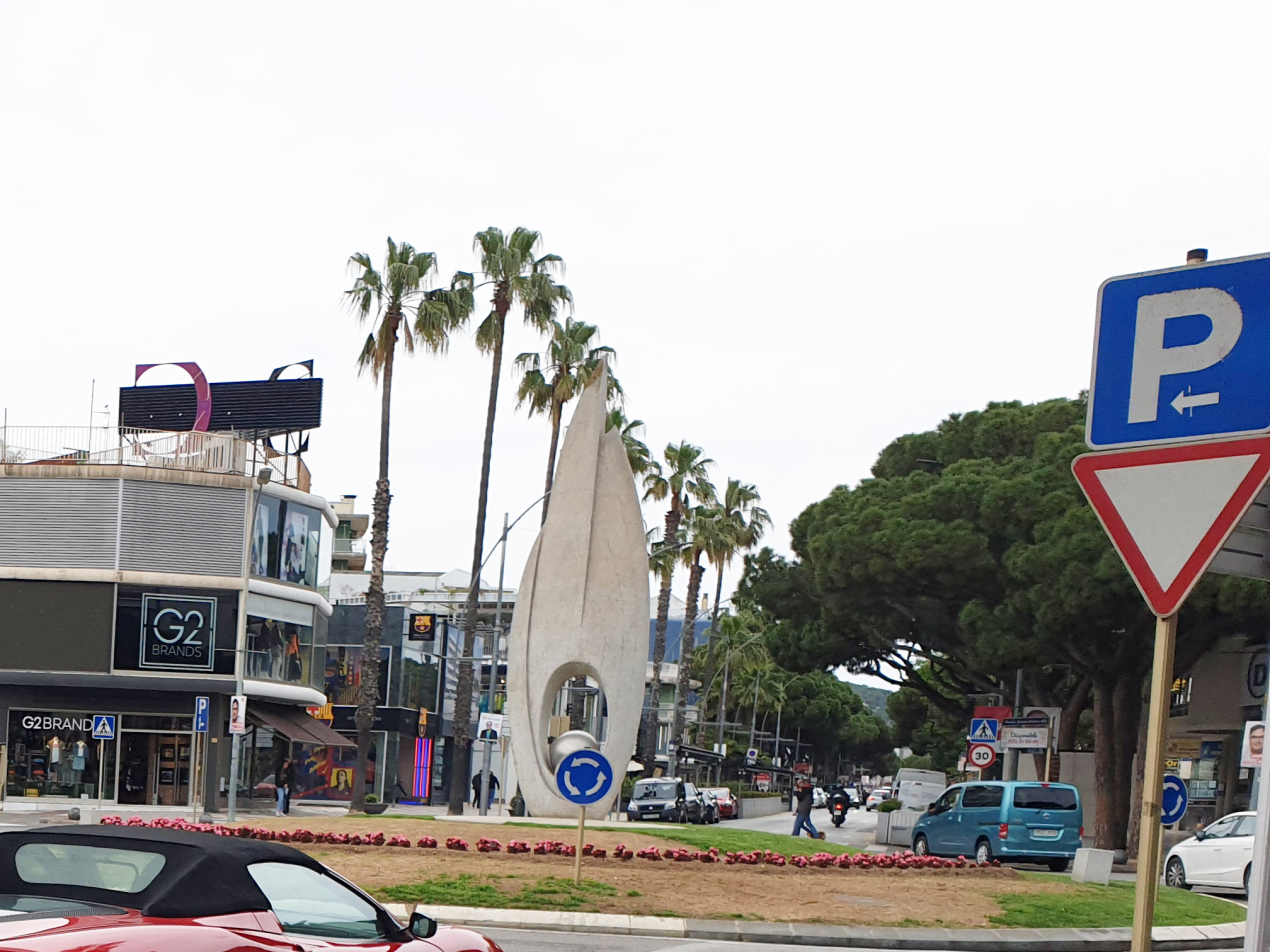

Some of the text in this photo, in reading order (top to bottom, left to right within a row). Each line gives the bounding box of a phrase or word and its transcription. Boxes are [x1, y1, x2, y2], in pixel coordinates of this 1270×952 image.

[1127, 286, 1243, 424] P
[153, 607, 204, 645] G2
[151, 644, 202, 658] BRANDS
[975, 752, 989, 761] 30
